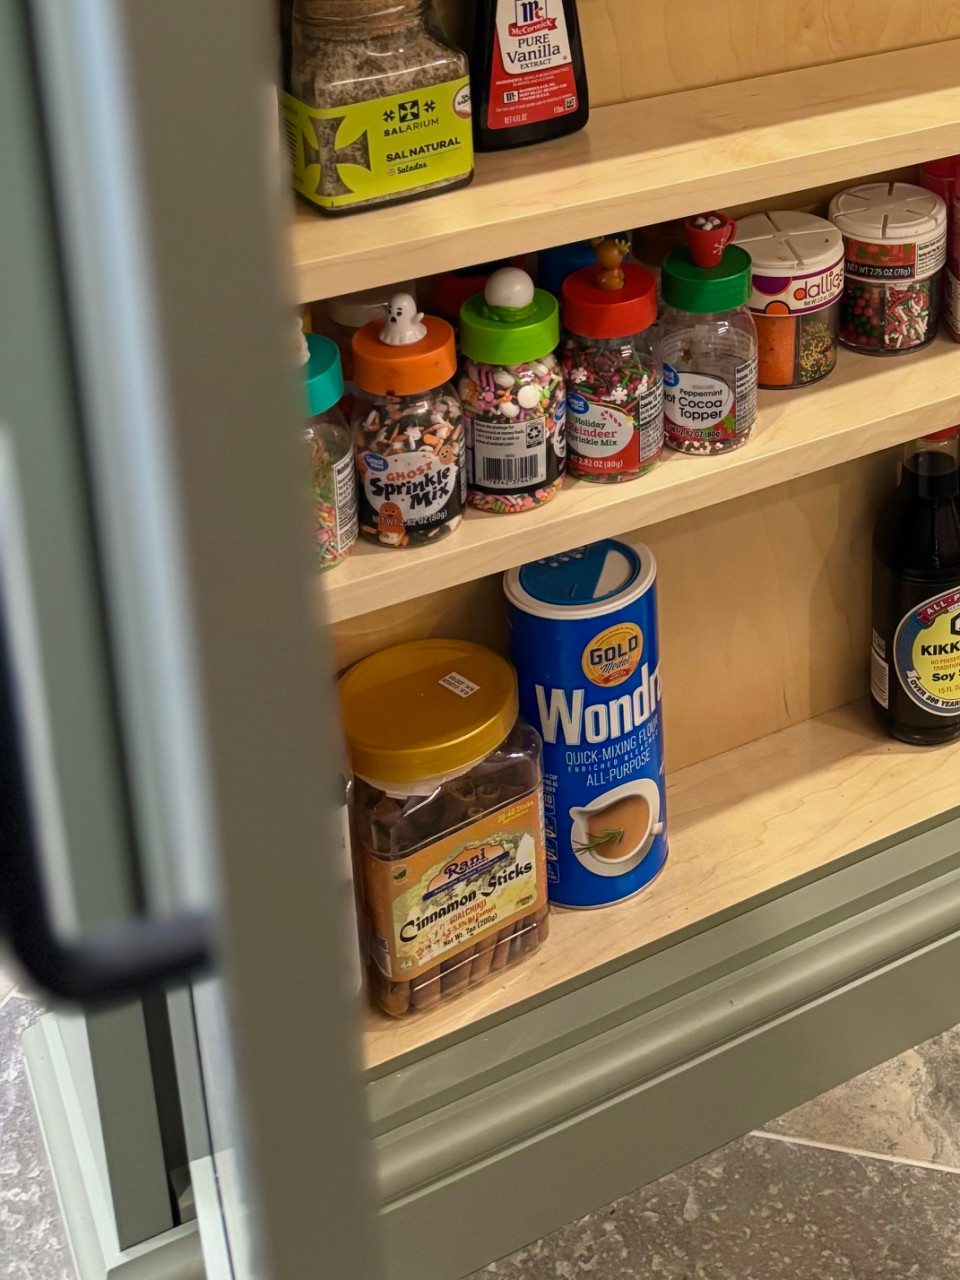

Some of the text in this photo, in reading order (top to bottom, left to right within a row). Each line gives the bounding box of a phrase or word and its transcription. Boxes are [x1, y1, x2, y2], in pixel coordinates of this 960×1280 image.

[511, 19, 553, 36] McCormick
[517, 33, 550, 49] PURE
[506, 43, 561, 64] Vanilla
[520, 57, 553, 70] EXTRACT
[383, 117, 440, 138] SALARIUM
[386, 136, 462, 162] SAL NATURAL
[396, 162, 428, 175] Saladas
[678, 396, 723, 409] Cocoa
[680, 388, 723, 398] Peppermint
[575, 417, 607, 430] Holiday
[679, 407, 723, 422] Topper
[600, 439, 618, 447] Mix
[386, 461, 433, 482] GHOST
[369, 466, 451, 501] Sprinkle
[409, 481, 450, 510] Mix
[589, 634, 639, 666] GOLD
[600, 654, 633, 674] Medal
[932, 672, 956, 682] Soy
[910, 679, 927, 698] OVER
[565, 714, 659, 766] QUICK-MIXING FLOUR
[567, 760, 619, 773] ENRICHED
[586, 747, 651, 788] ALL-PURPOSE
[443, 847, 488, 880] Rani
[399, 861, 533, 943] Cinnamon Sticks
[443, 936, 455, 947] Net
